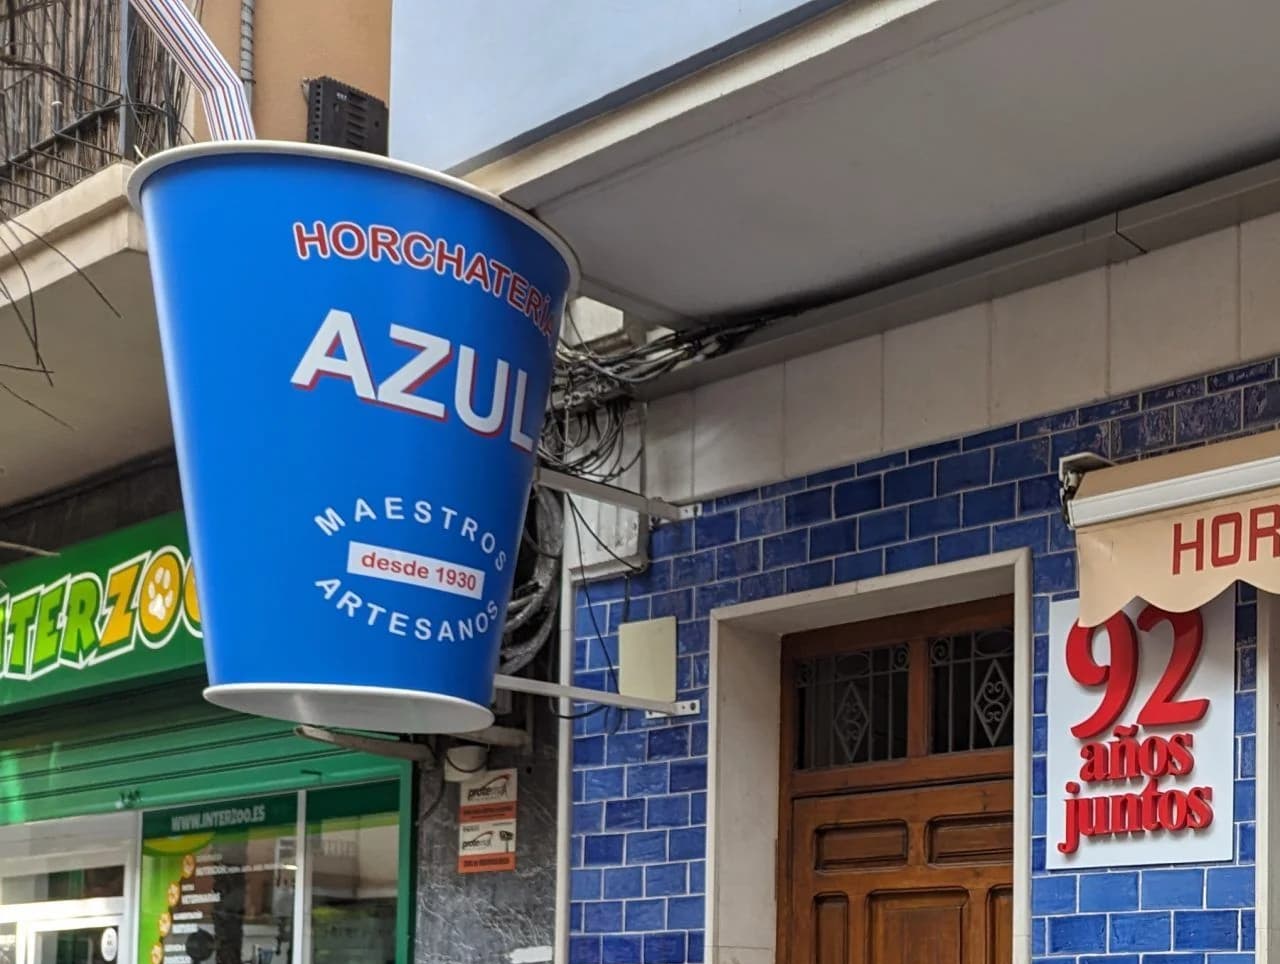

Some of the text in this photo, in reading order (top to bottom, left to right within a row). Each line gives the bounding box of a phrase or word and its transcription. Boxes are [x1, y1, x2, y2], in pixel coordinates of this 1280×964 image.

[290, 307, 534, 454] AZUL
[313, 496, 507, 572] MAESTROS
[361, 552, 477, 592] desde 1930
[0, 546, 204, 682] TERZO
[314, 576, 498, 643] ARTESANOS
[1065, 601, 1211, 739] 92
[1079, 723, 1196, 785] años
[1057, 779, 1214, 855] juntos
